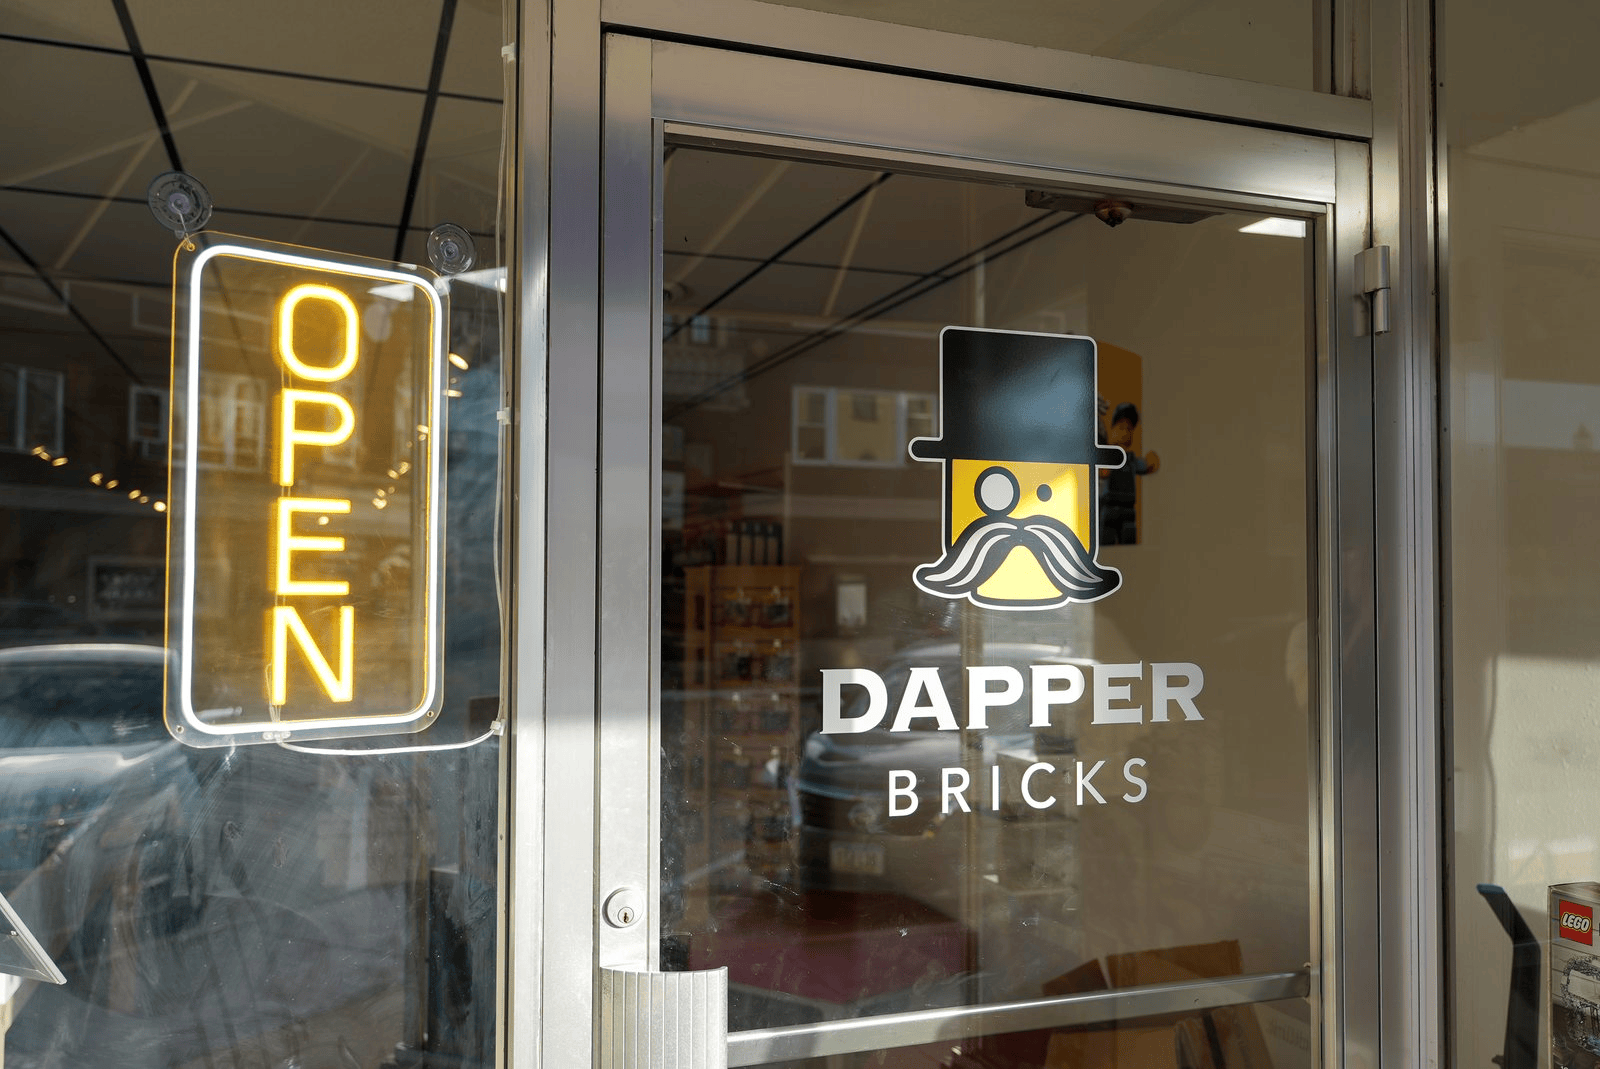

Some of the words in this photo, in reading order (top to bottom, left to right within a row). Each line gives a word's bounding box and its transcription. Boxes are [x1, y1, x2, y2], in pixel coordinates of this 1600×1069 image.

[270, 282, 360, 706] OPEN
[819, 660, 1204, 734] DAPPER
[888, 757, 1148, 817] BRICKS
[1562, 912, 1591, 932] LEGO
